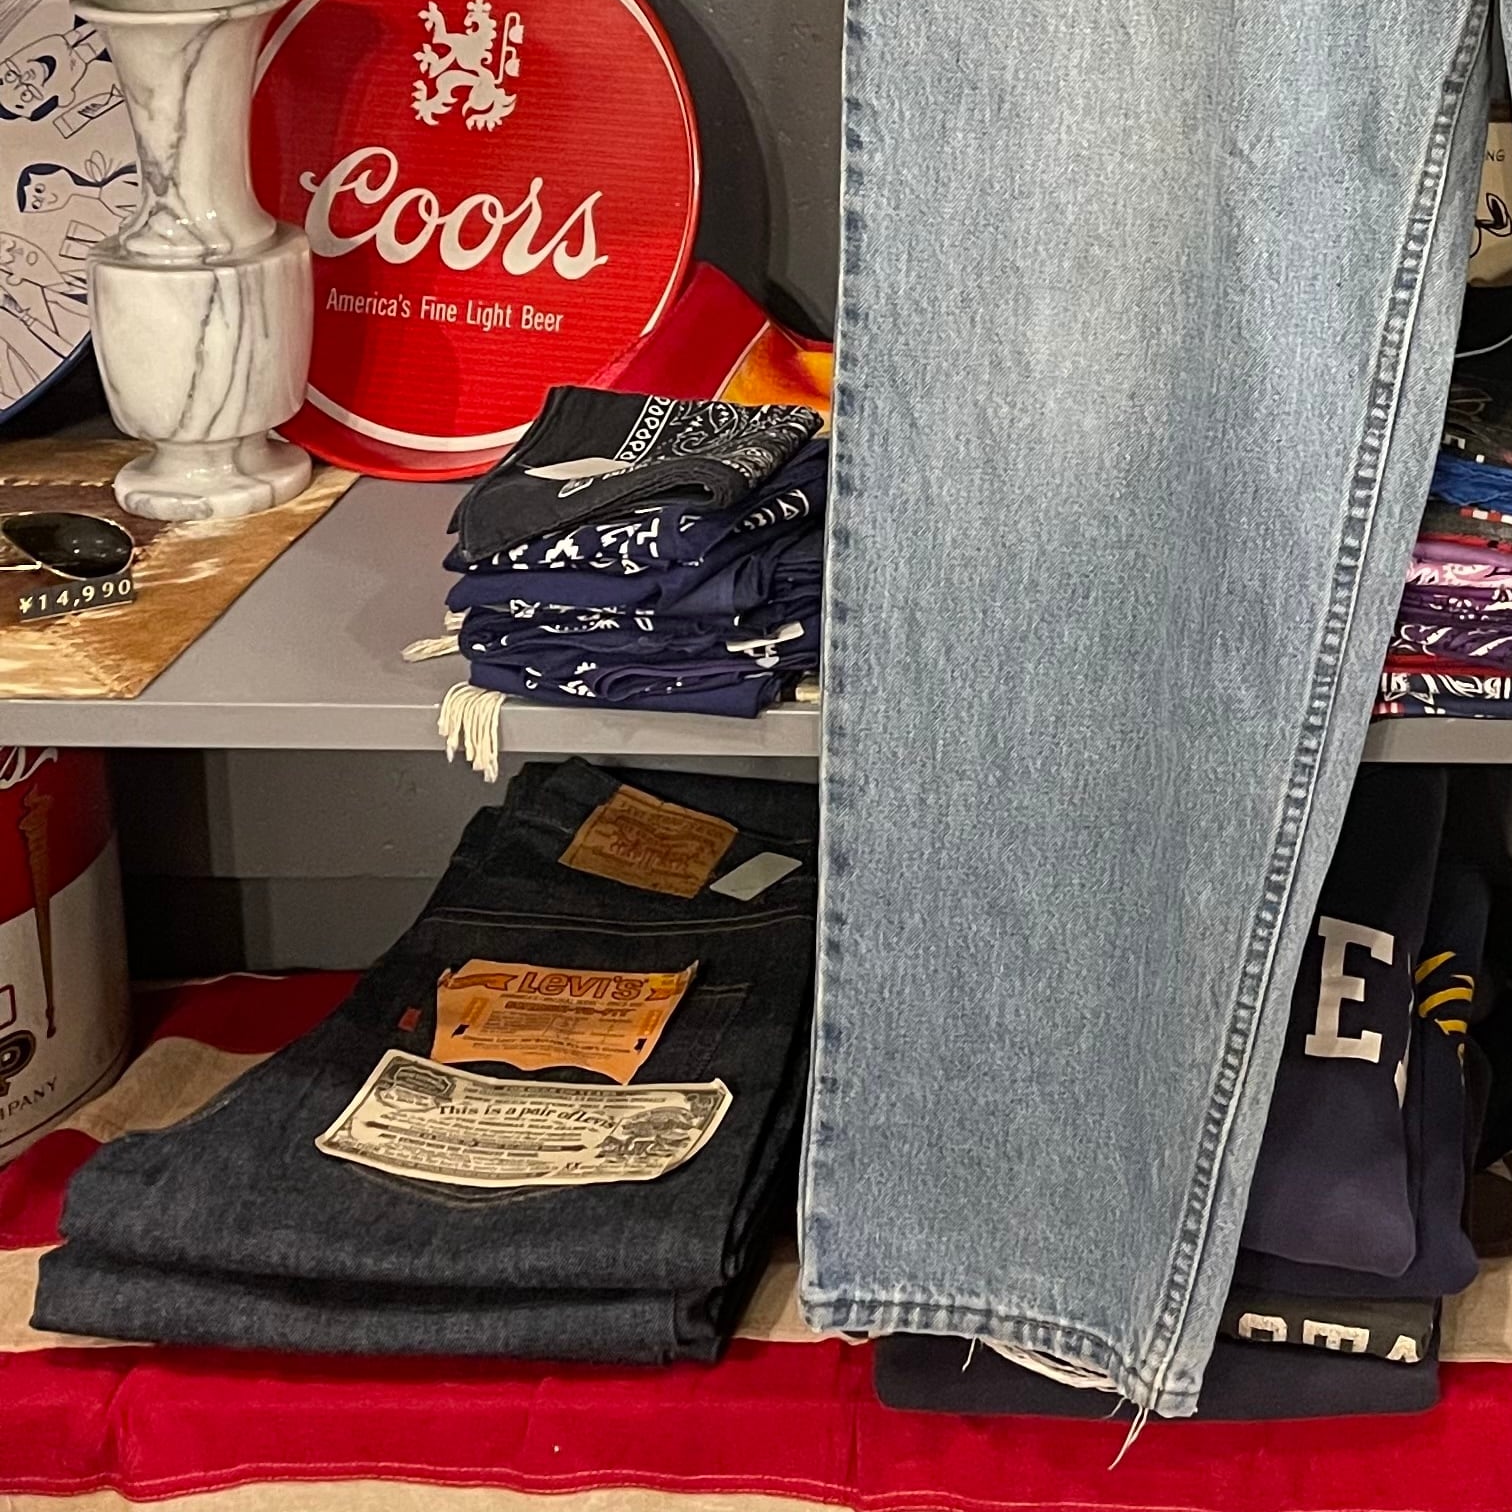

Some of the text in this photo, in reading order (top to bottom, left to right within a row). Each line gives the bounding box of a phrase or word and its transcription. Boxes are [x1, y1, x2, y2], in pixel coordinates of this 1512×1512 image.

[1485, 148, 1506, 162] NG
[299, 146, 609, 281] Coors
[326, 287, 564, 333] America's Fine Light Beer
[19, 578, 131, 614] ¥14,990
[0, 1075, 57, 1120] PANY
[439, 1104, 479, 1115] This
[484, 1100, 502, 1115] is
[505, 1106, 517, 1115] a
